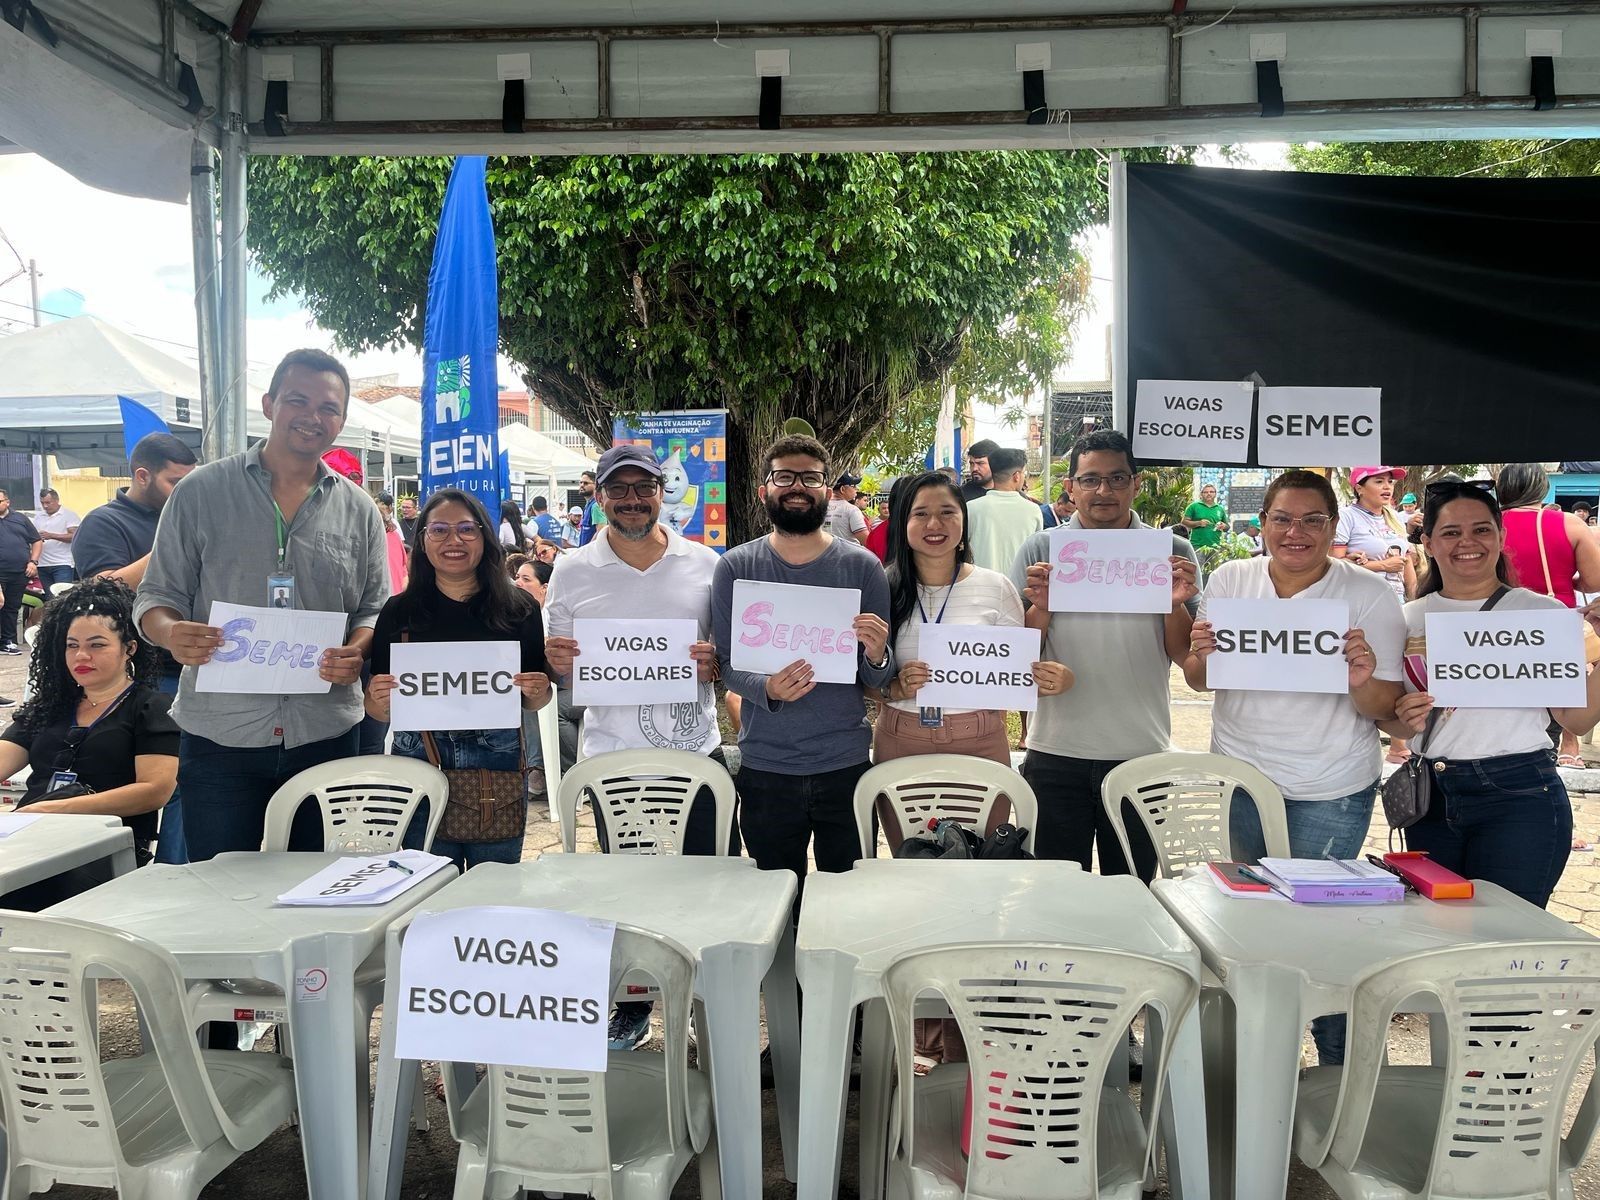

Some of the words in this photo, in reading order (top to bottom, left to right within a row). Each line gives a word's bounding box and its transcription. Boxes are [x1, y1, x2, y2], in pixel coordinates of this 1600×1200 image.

[1164, 396, 1223, 412] VAGAS
[672, 418, 711, 428] VACINAÇÃO
[1138, 422, 1245, 441] ESCOLARES
[1265, 415, 1374, 437] SEMEC
[428, 428, 493, 476] ELÉM
[214, 617, 327, 668] SEME
[604, 636, 668, 652] VAGAS
[1215, 629, 1340, 655] SEMEC
[1463, 630, 1545, 647] VAGAS
[948, 641, 1010, 657] VAGAS
[580, 666, 693, 682] ESCOLARES
[1434, 663, 1581, 680] ESCOLARES
[399, 671, 514, 696] SEMEC
[320, 863, 390, 895] SEMEC
[453, 935, 559, 968] VAGAS
[409, 986, 600, 1025] ESCOLARES
